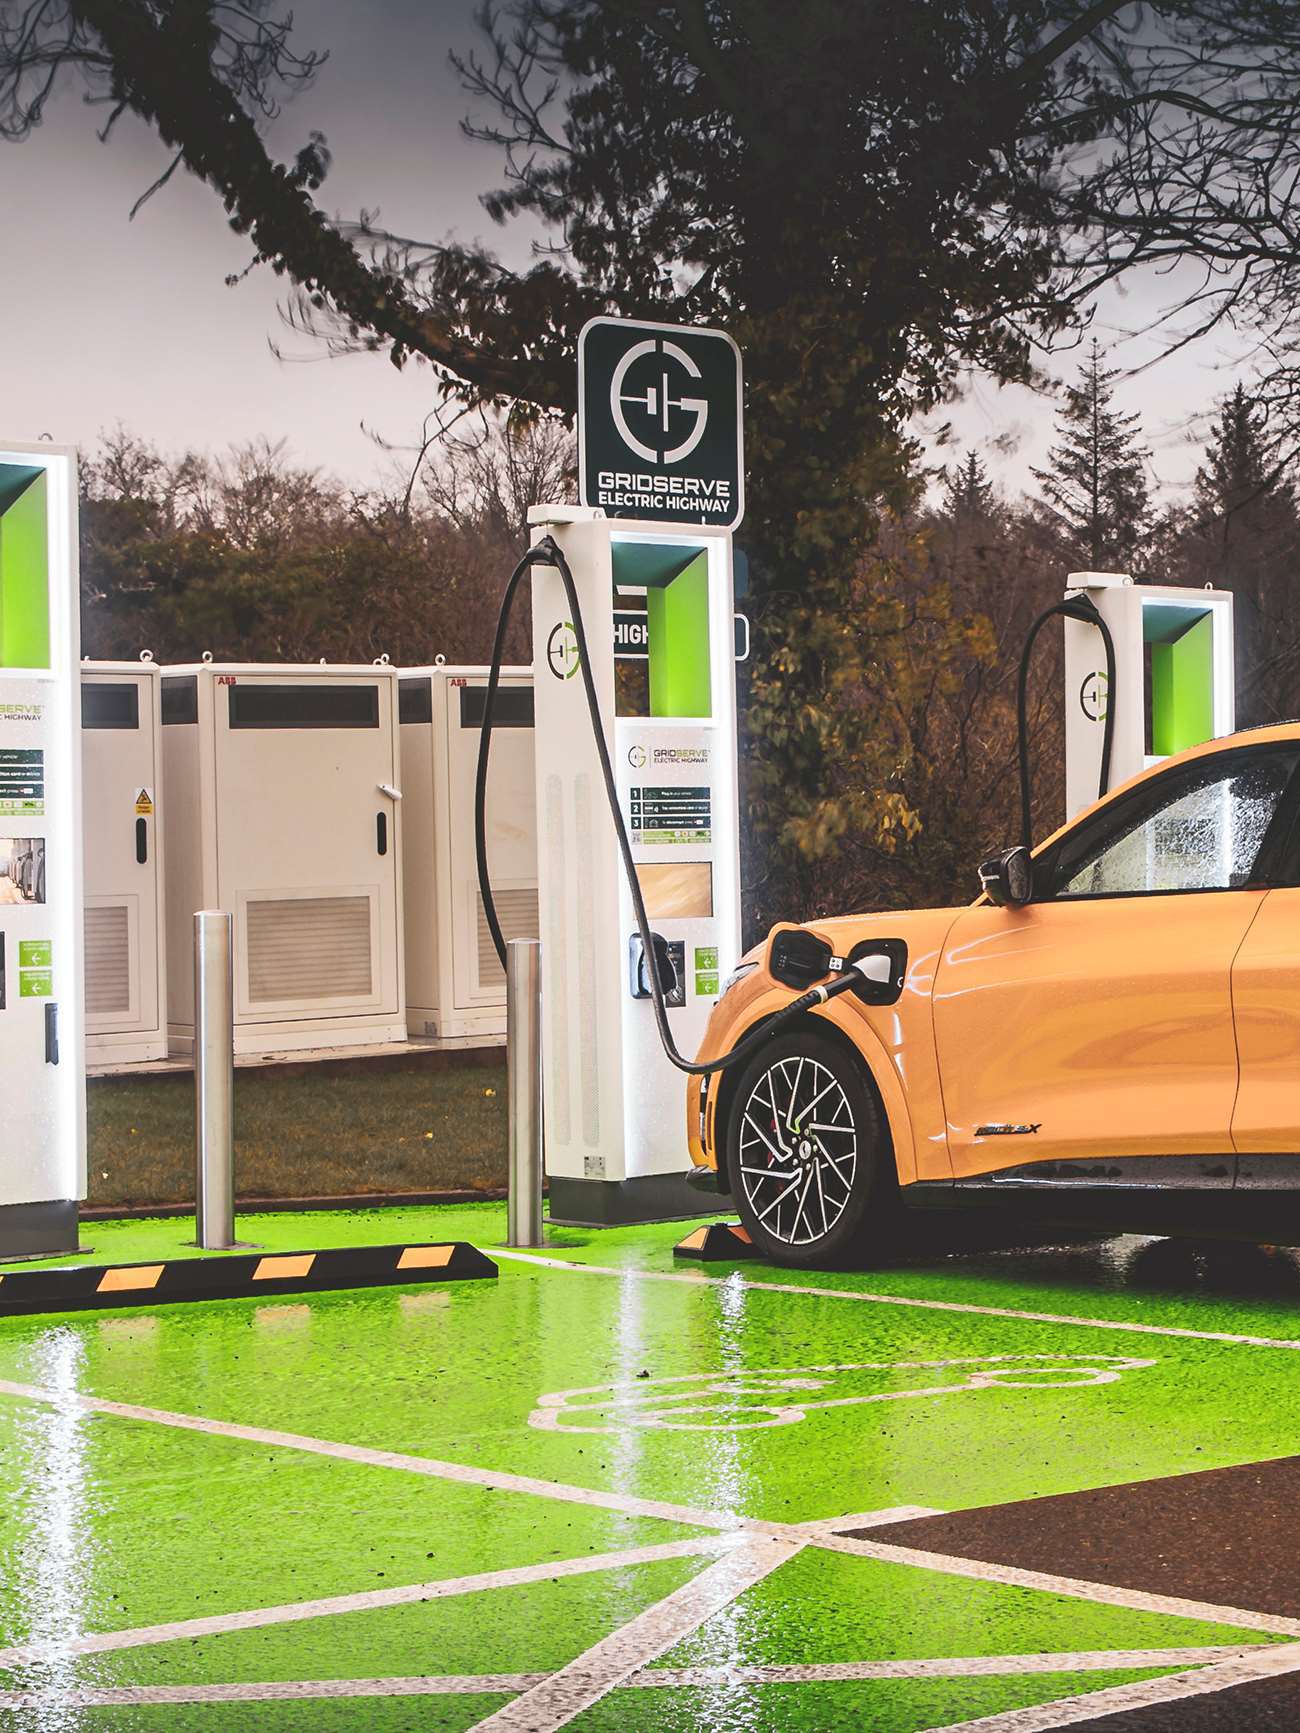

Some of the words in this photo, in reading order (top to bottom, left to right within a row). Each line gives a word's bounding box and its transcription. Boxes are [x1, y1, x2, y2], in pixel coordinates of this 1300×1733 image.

[598, 471, 730, 498] GRIDSERVE
[598, 491, 663, 508] ELECTRIC
[666, 496, 730, 513] HIGHWAY
[217, 676, 237, 685] ABB
[450, 678, 467, 687] ABB
[653, 749, 708, 757] GRIDSERVE
